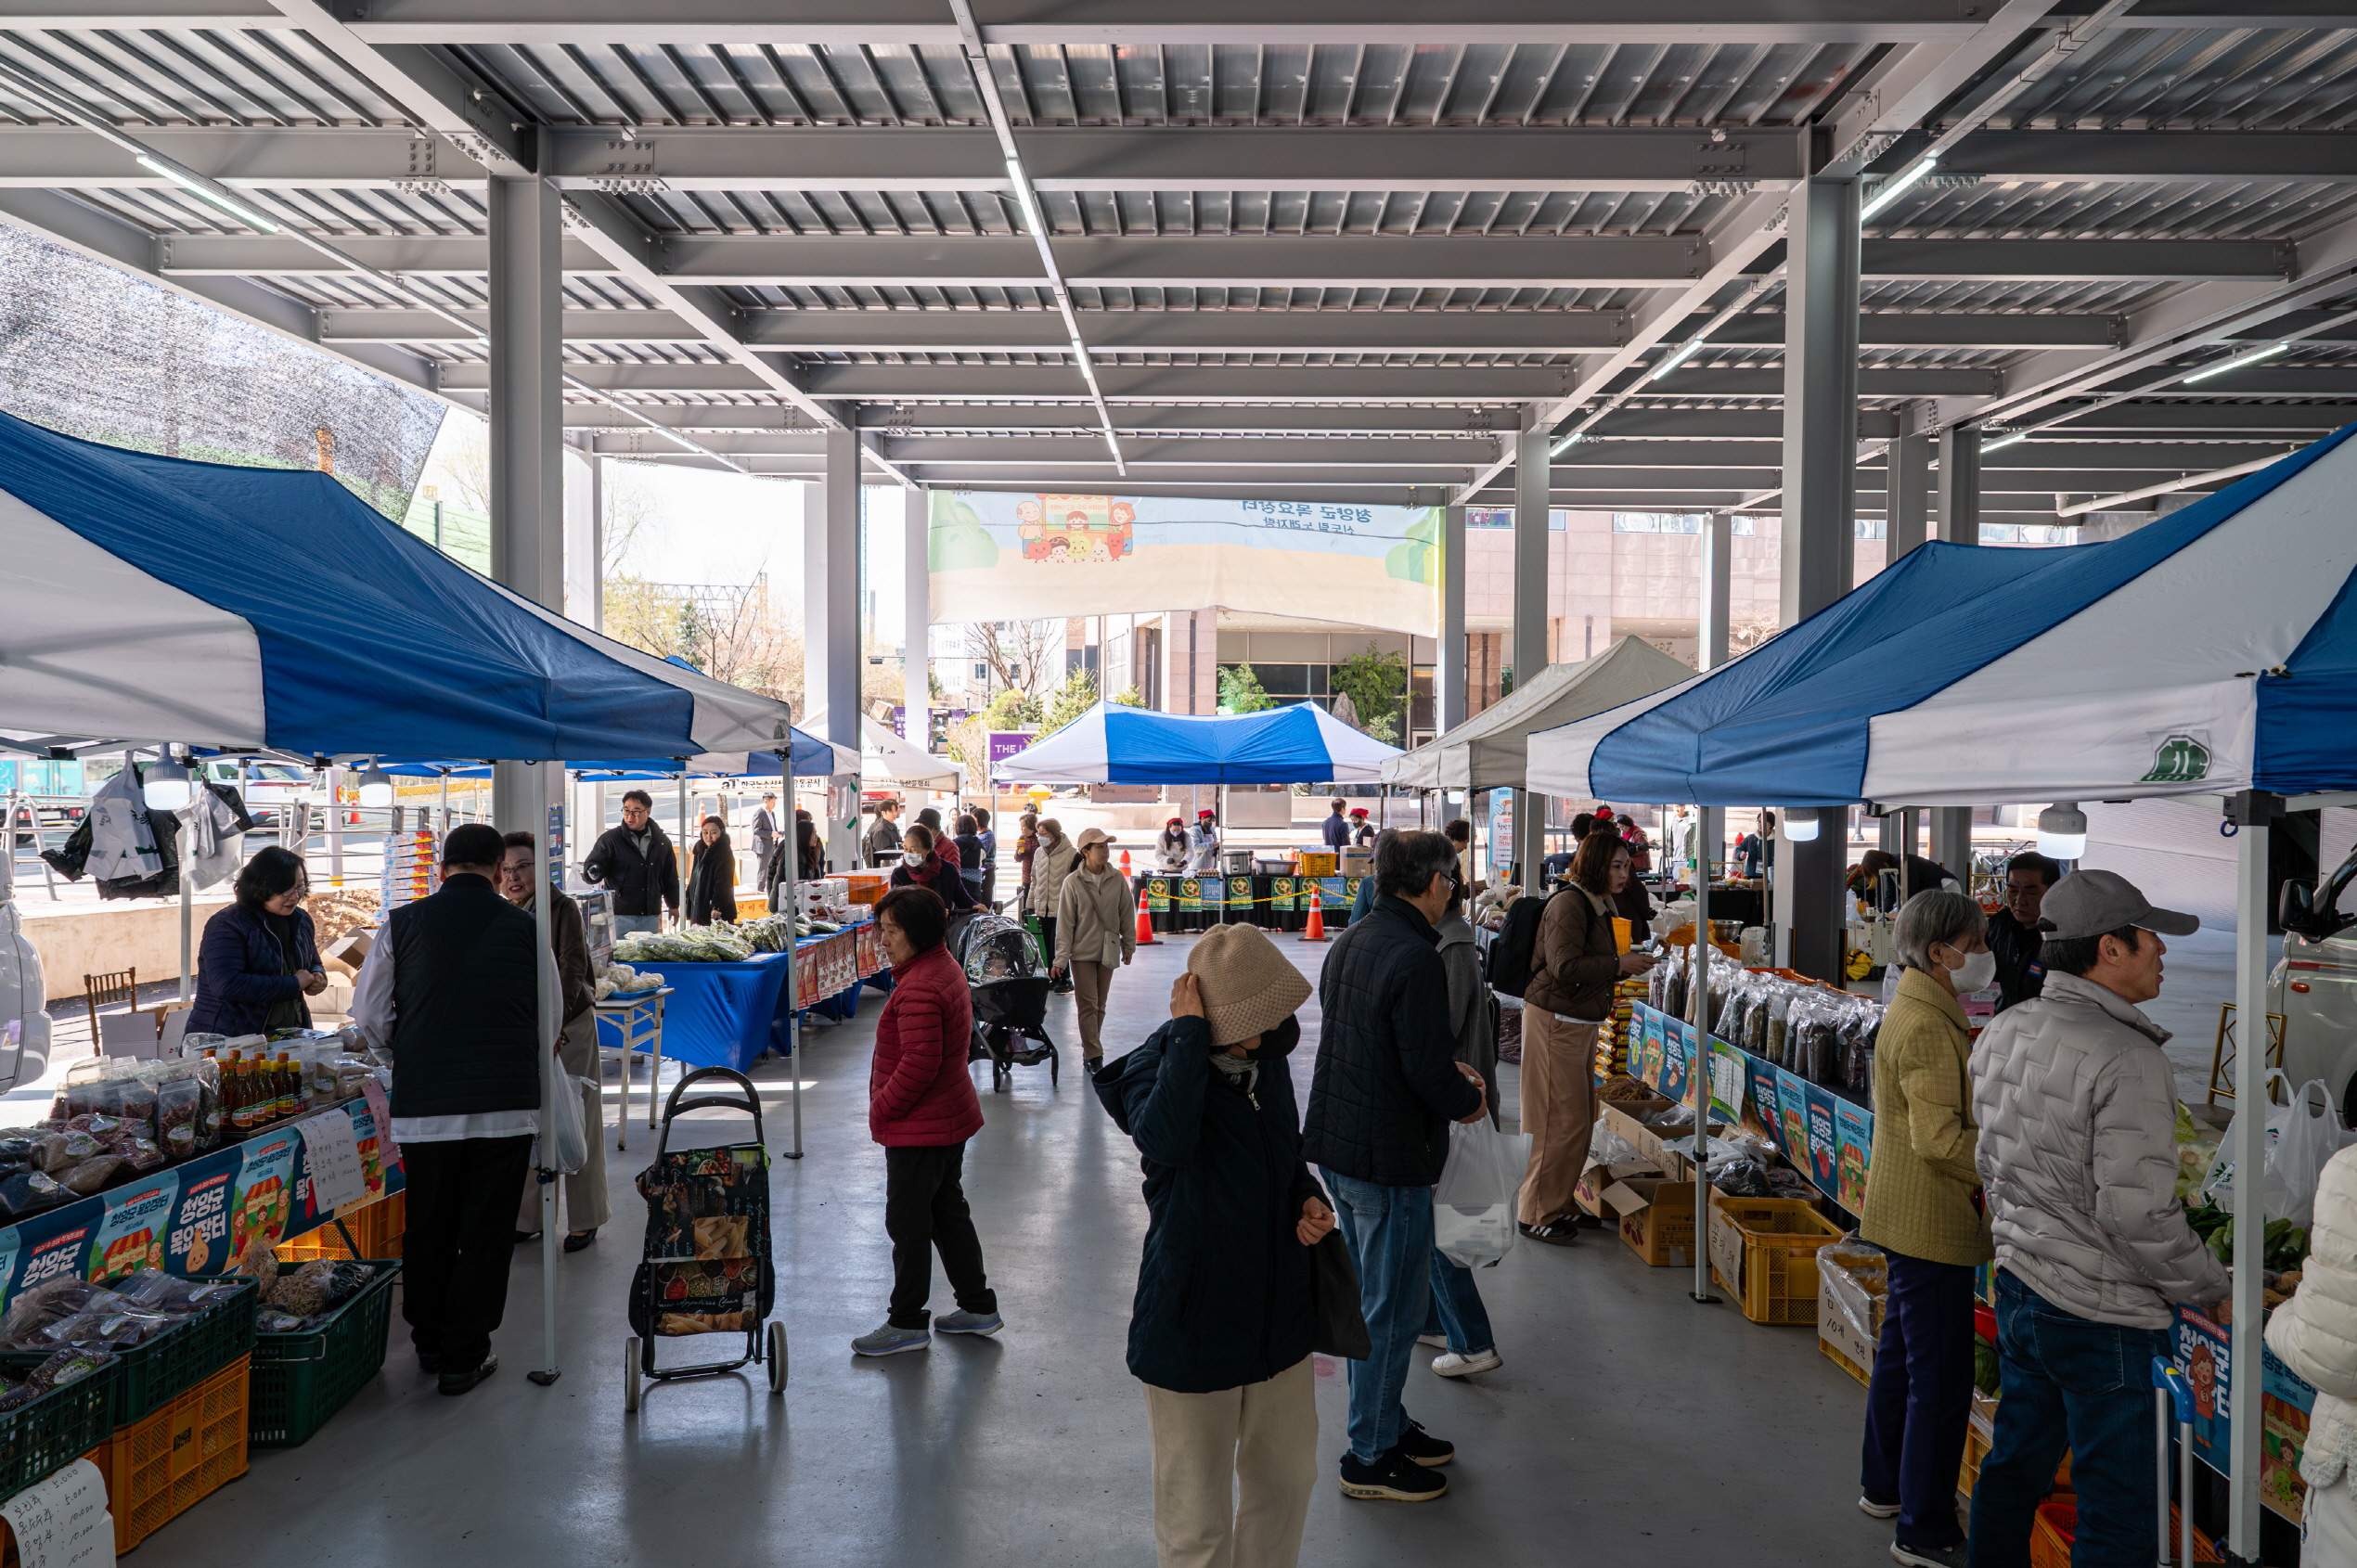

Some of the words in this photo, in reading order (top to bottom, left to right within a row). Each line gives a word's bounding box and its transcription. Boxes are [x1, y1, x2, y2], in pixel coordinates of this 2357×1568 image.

[995, 744, 1016, 753] THE
[1810, 1112, 1833, 1142] 청양군
[179, 1185, 225, 1226] 청양군
[170, 1210, 226, 1255] 목요장터
[20, 1241, 83, 1288] 청양군
[14, 1494, 43, 1519] 보리차
[19, 1508, 54, 1536] 옥수수차
